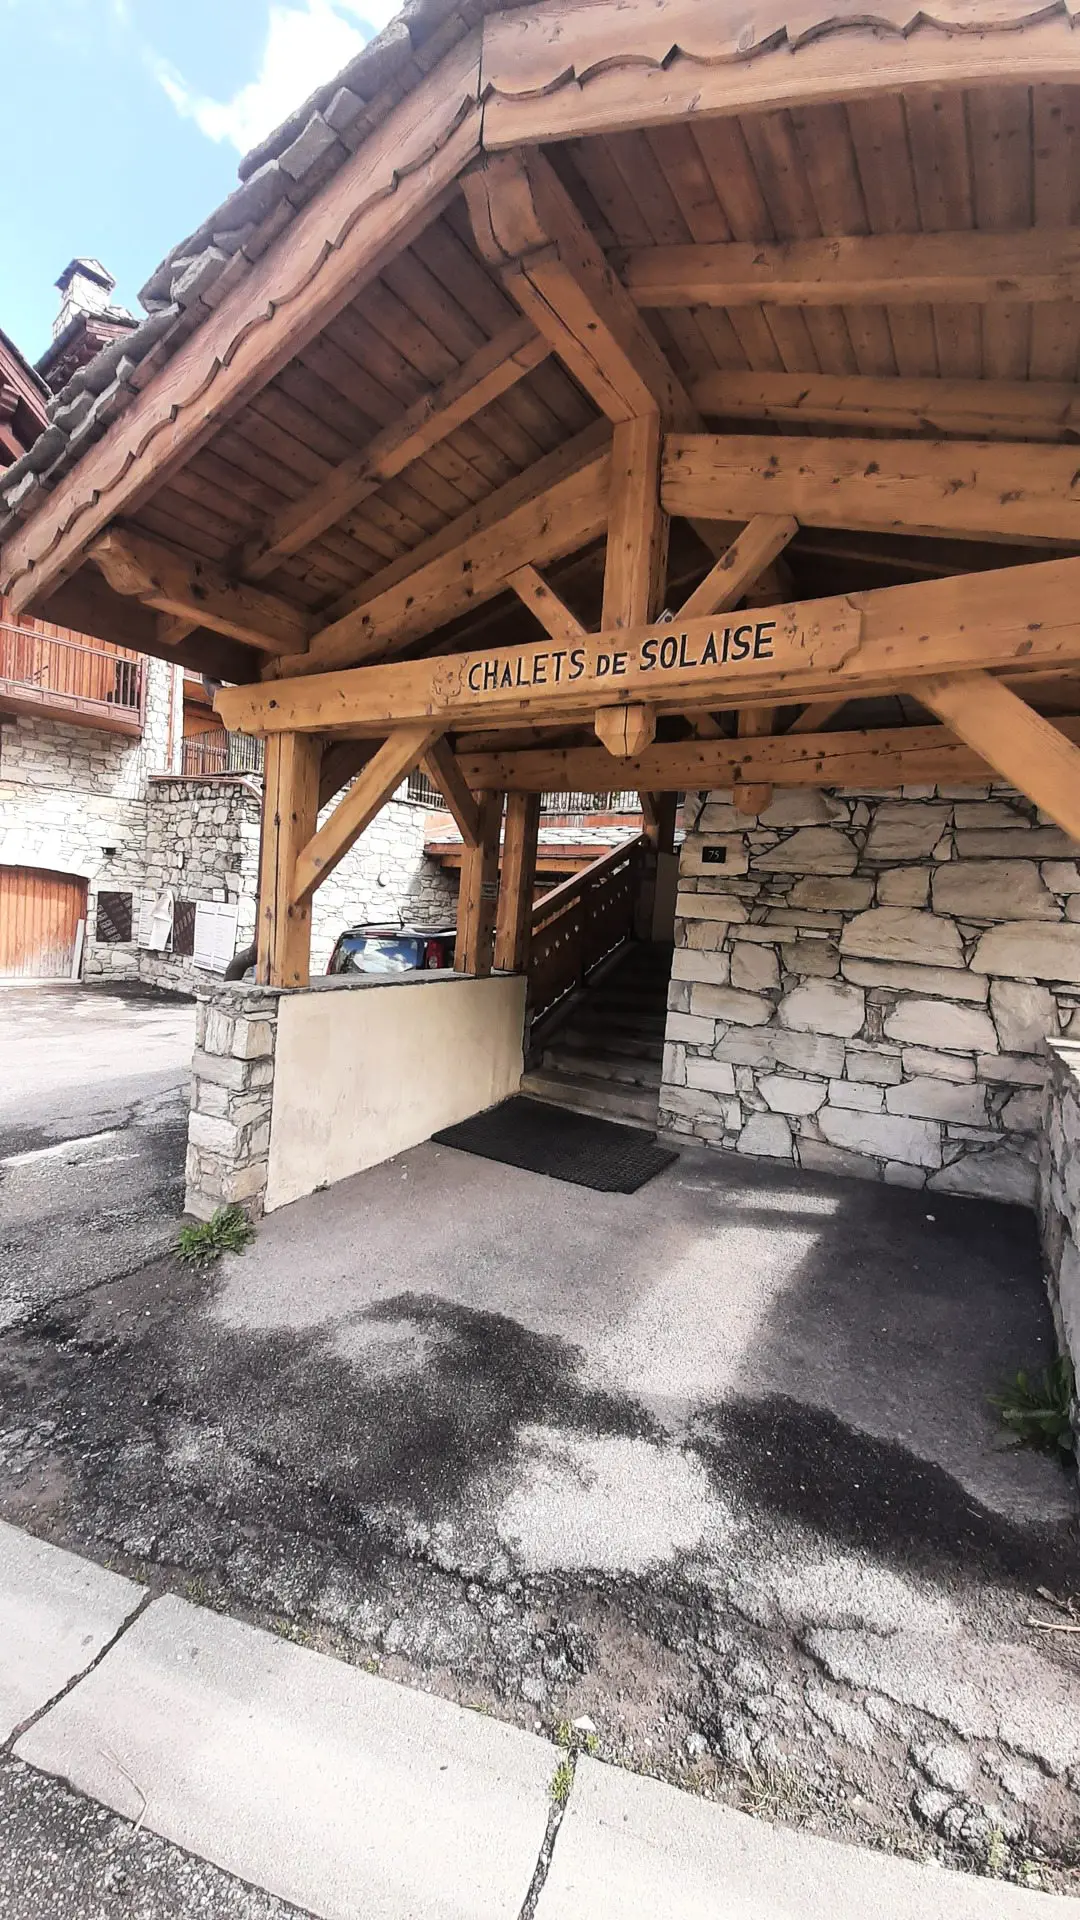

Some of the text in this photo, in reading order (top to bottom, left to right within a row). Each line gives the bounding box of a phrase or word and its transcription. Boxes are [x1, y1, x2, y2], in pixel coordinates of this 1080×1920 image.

[468, 621, 776, 690] CHALETS DE SOLAISE
[708, 850, 720, 860] 75
